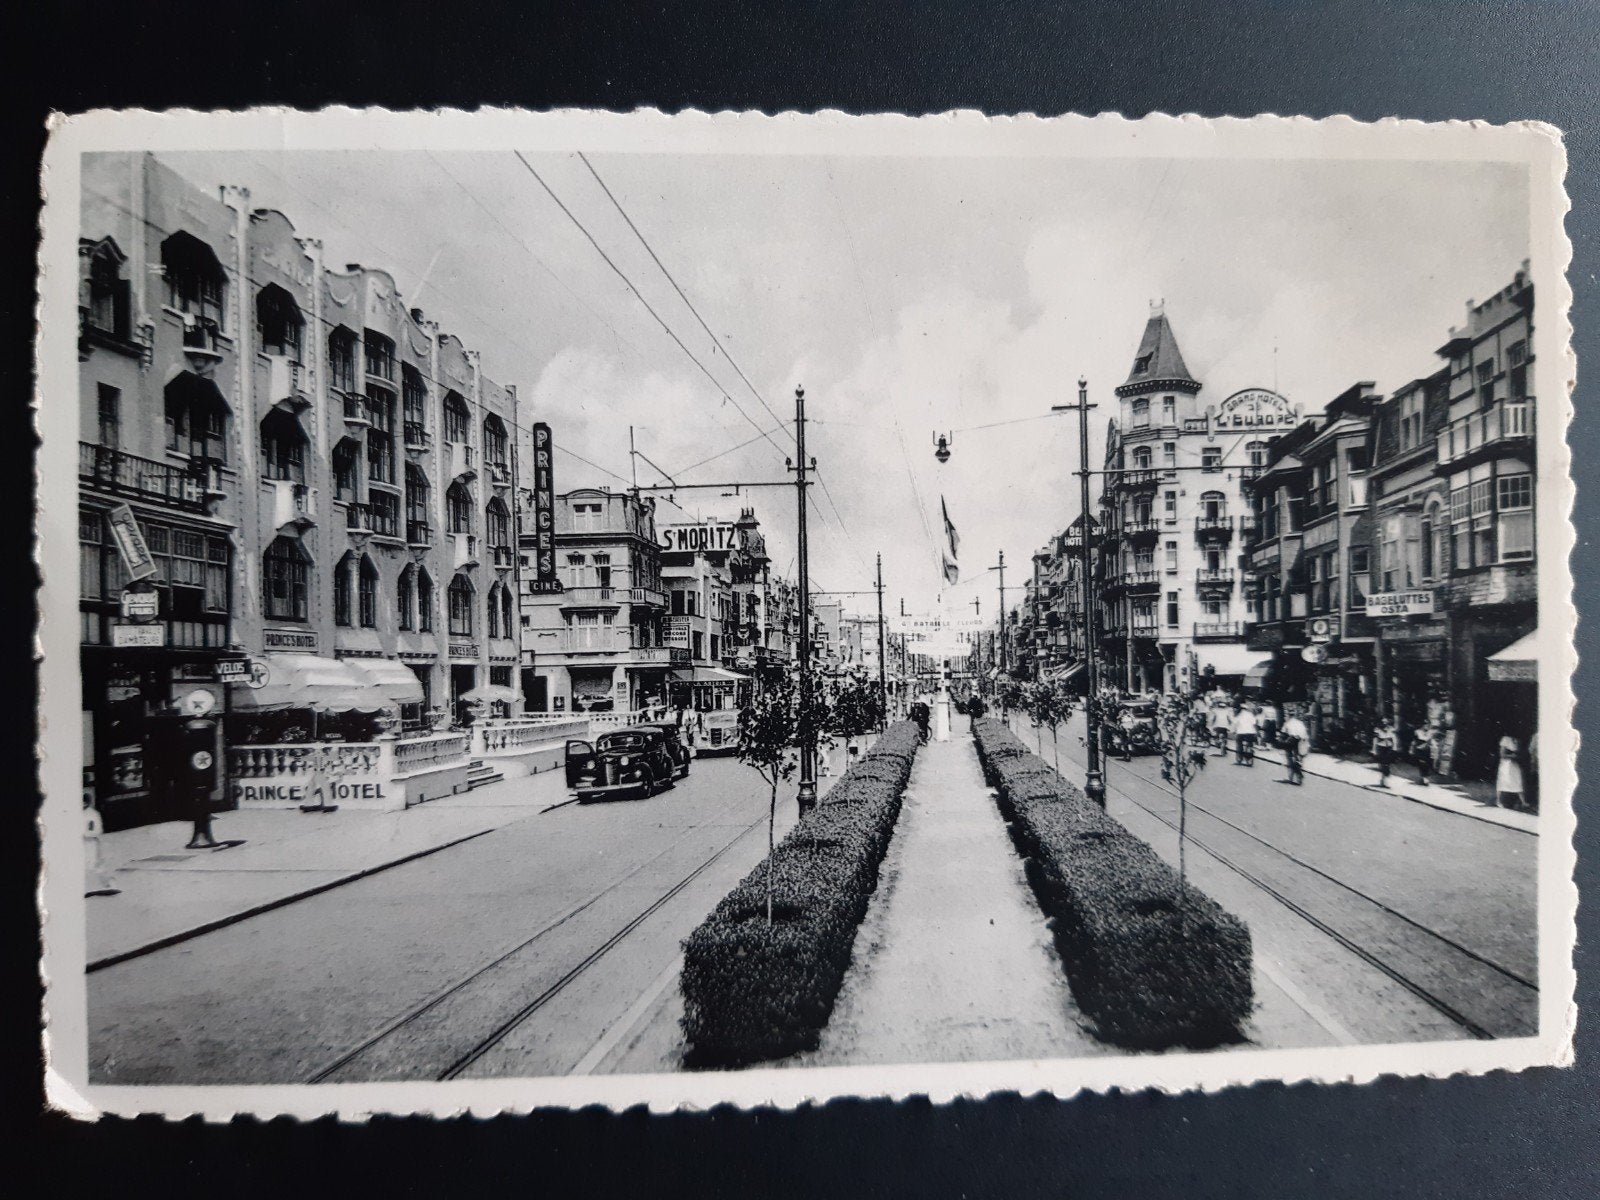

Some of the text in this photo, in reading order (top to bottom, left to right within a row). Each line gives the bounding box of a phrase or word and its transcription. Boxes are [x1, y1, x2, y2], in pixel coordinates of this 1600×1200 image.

[1257, 394, 1283, 411] HOTEL
[677, 526, 736, 550] MORITZ
[231, 784, 307, 801] PRINCE
